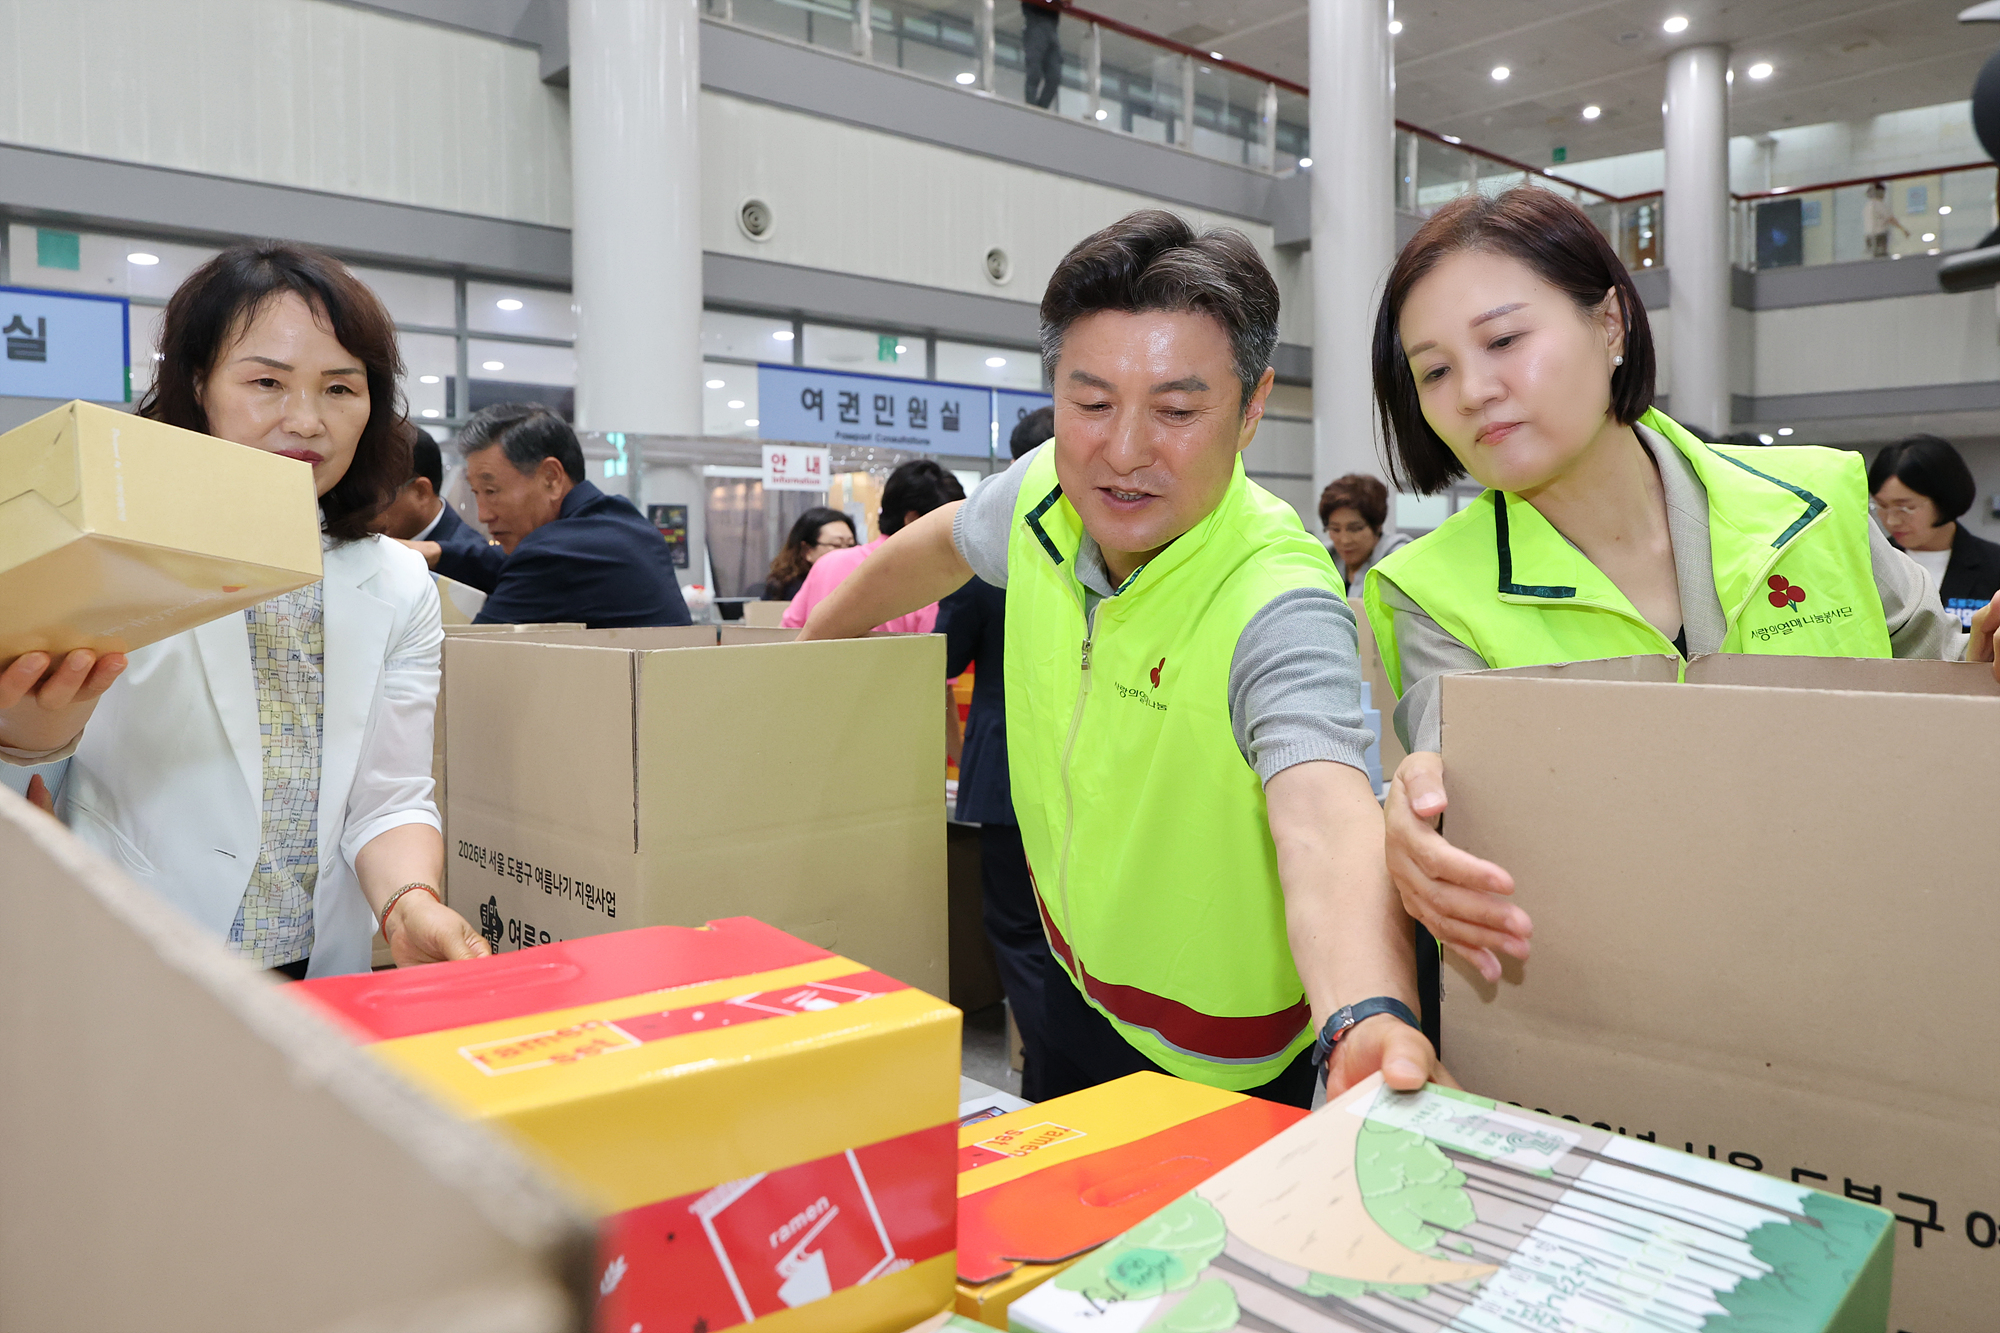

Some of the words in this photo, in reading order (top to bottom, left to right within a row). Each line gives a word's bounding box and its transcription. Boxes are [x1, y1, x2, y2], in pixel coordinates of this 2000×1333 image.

[3, 314, 47, 363] 실
[801, 387, 961, 432] 여권민원실
[458, 839, 487, 869] 2026년
[488, 849, 505, 877] 서울
[506, 856, 533, 886] 도봉구
[534, 866, 572, 900] 여름나기
[574, 880, 617, 919] 지원사업
[986, 1129, 1024, 1146] set
[1009, 1126, 1072, 1158] ramen
[768, 1195, 831, 1249] ramen
